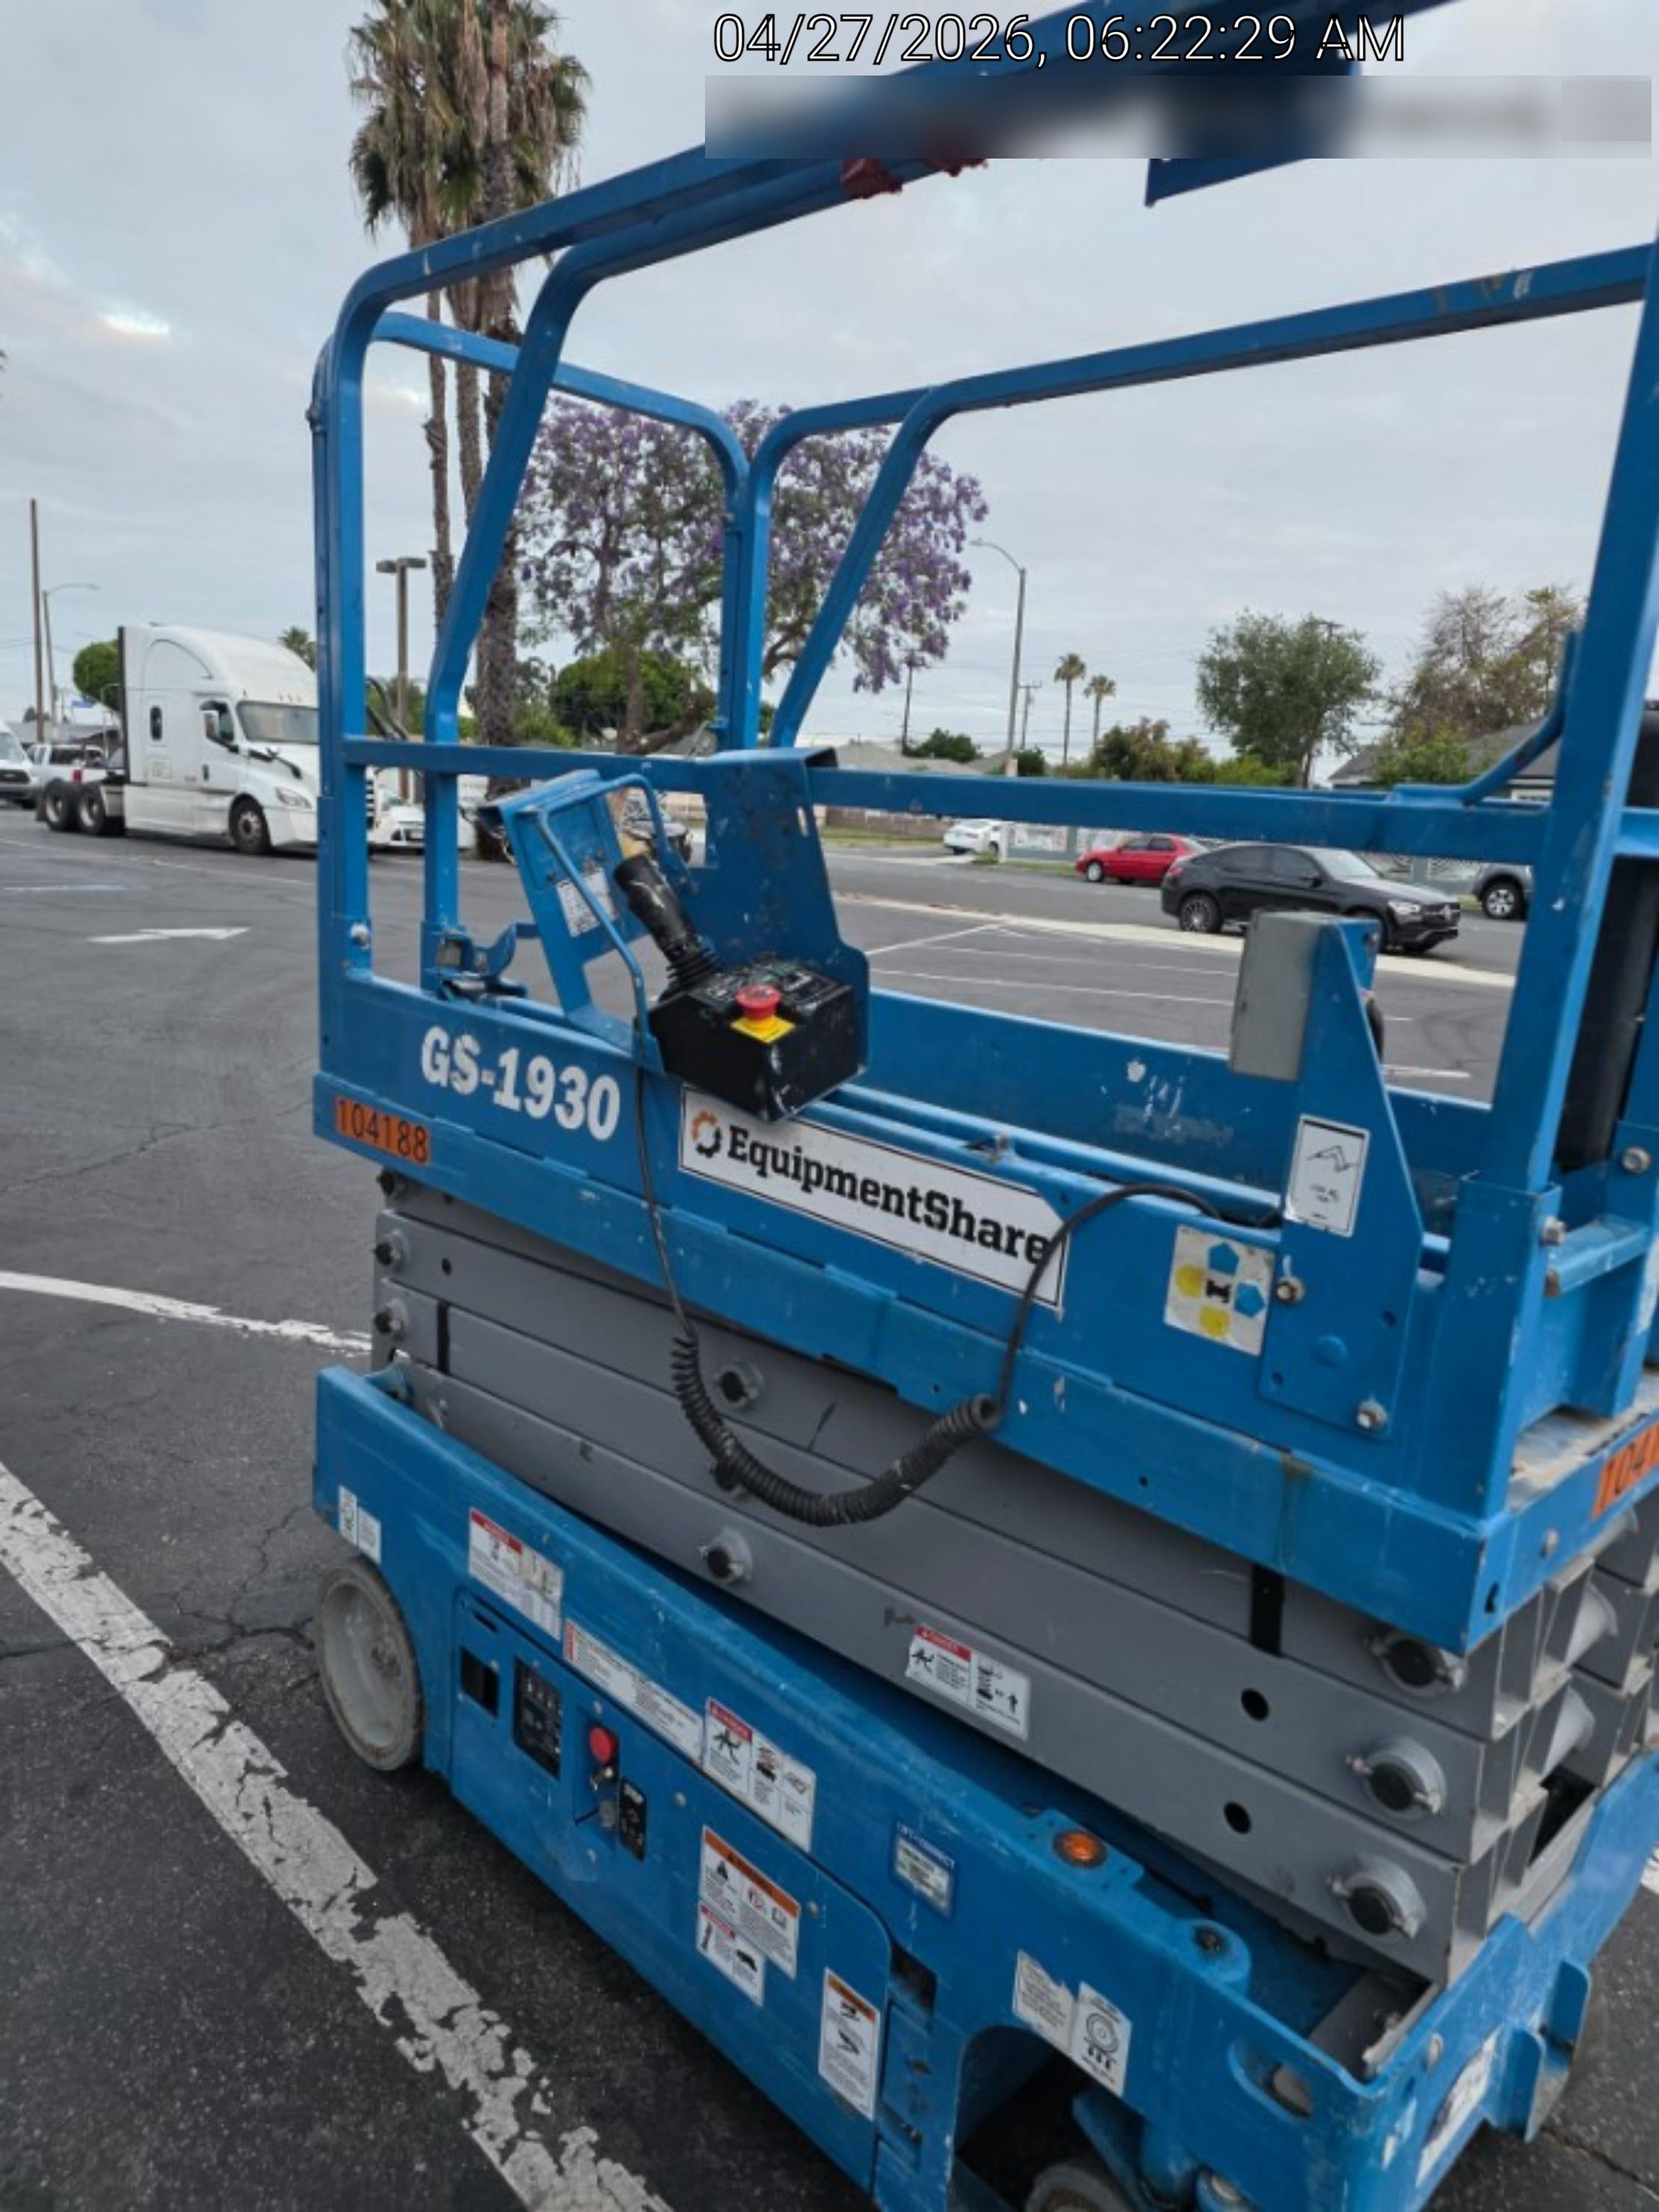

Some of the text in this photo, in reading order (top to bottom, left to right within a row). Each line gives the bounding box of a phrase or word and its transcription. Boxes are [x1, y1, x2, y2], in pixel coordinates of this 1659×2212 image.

[337, 1097, 428, 1163] 104188
[421, 1025, 621, 1141] GS-1930
[727, 1125, 1051, 1265] EquipmentShare
